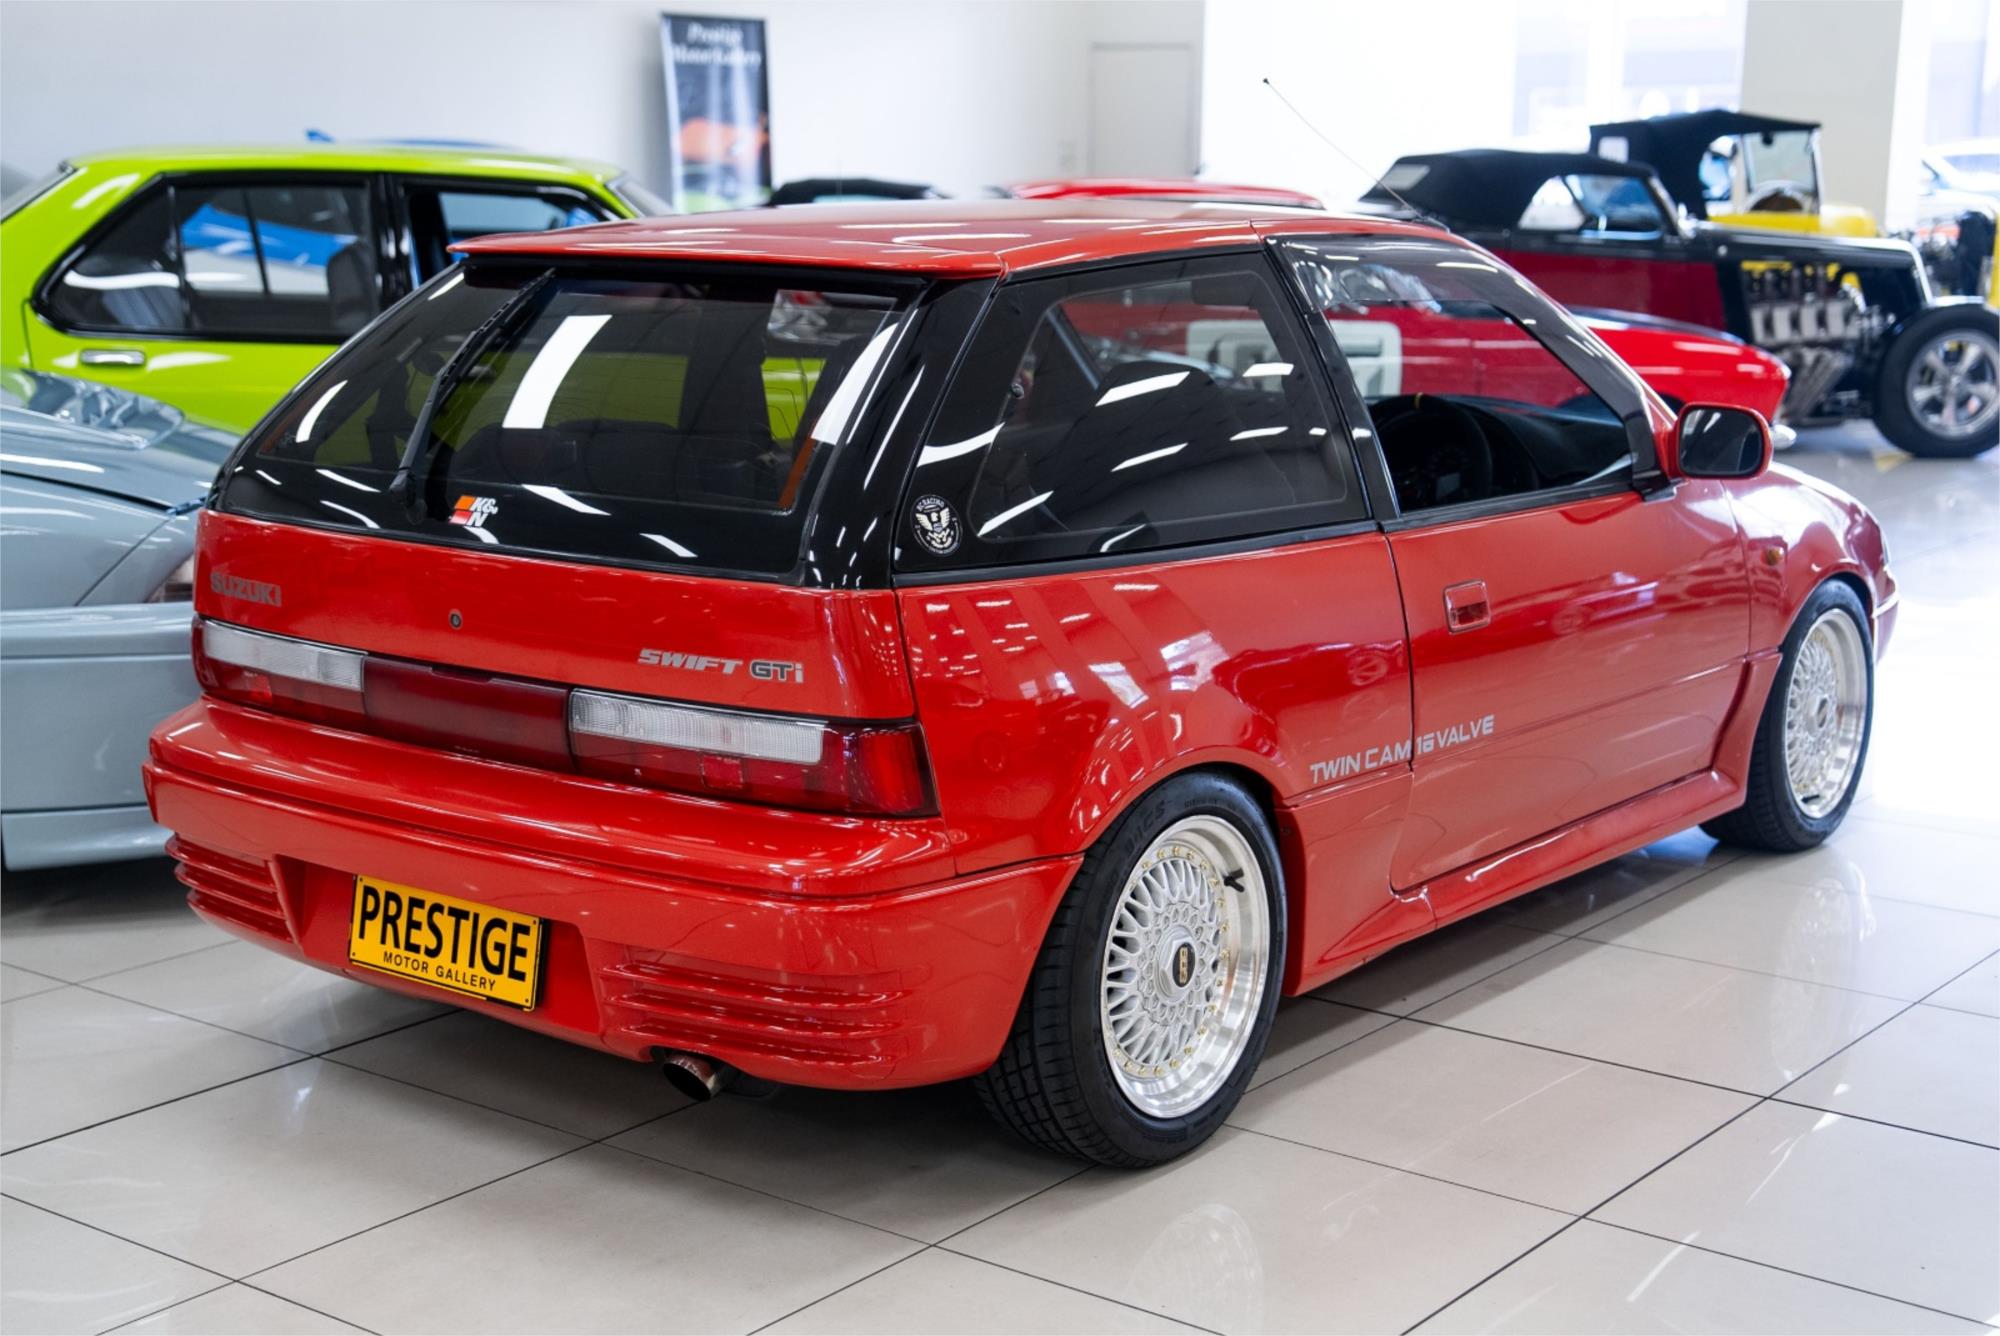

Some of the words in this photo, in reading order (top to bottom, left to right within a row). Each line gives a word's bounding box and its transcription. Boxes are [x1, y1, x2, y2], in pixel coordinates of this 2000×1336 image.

[210, 571, 282, 608] SUZUKI
[637, 647, 744, 676] SWIFT
[749, 658, 804, 684] GTi
[1310, 751, 1362, 785] TWIN
[1365, 739, 1412, 769] CAM
[358, 884, 532, 983] PRESTIGE
[383, 950, 429, 974] MOTOR
[435, 964, 497, 992] GALLERY
